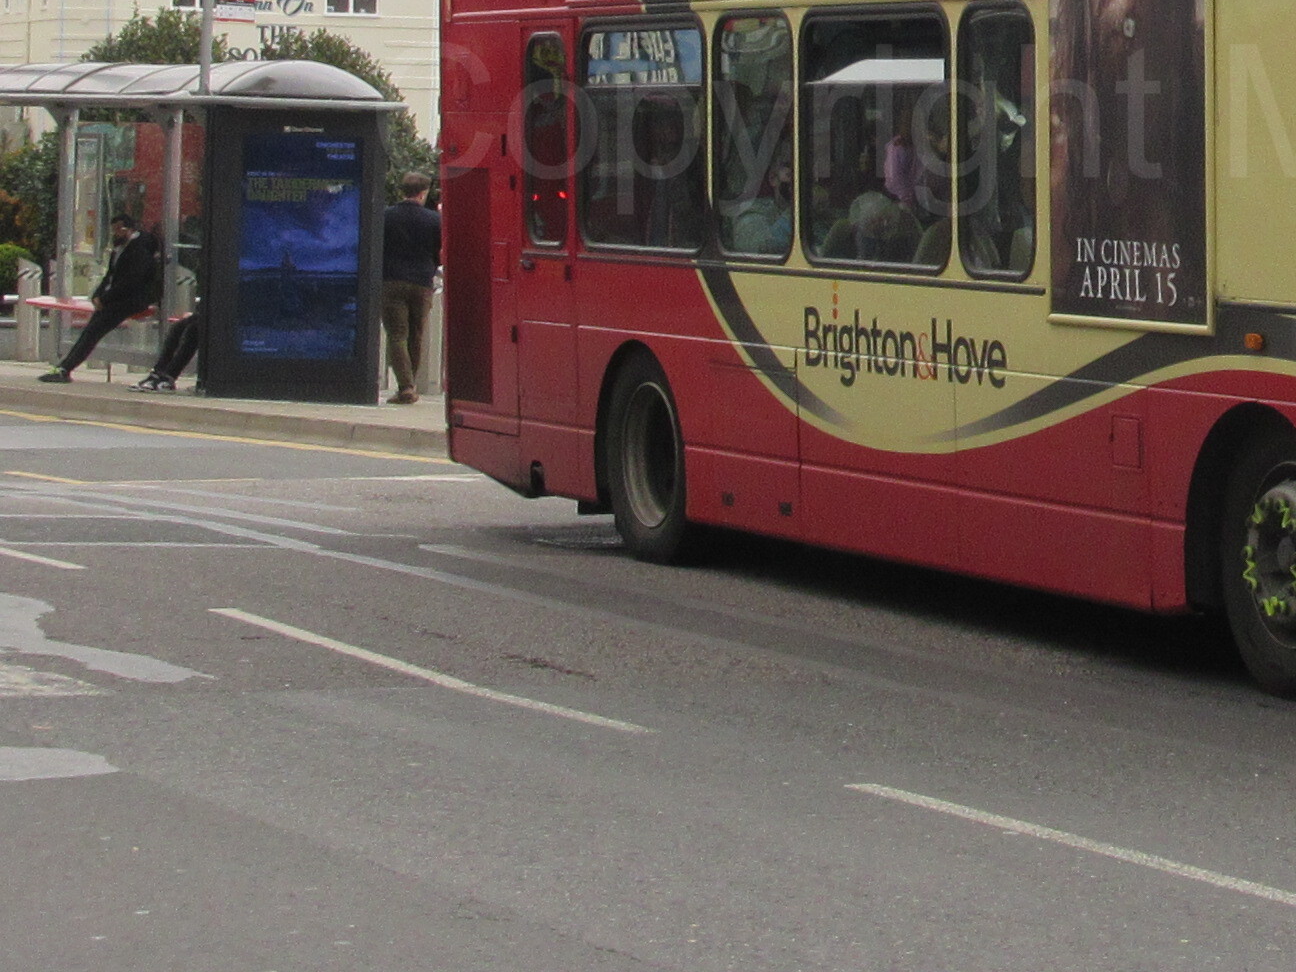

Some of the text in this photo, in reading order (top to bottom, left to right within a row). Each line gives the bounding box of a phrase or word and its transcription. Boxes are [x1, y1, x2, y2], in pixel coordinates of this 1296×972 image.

[1076, 237, 1181, 269] IN CINEMAS
[1079, 265, 1178, 307] APRIL 15
